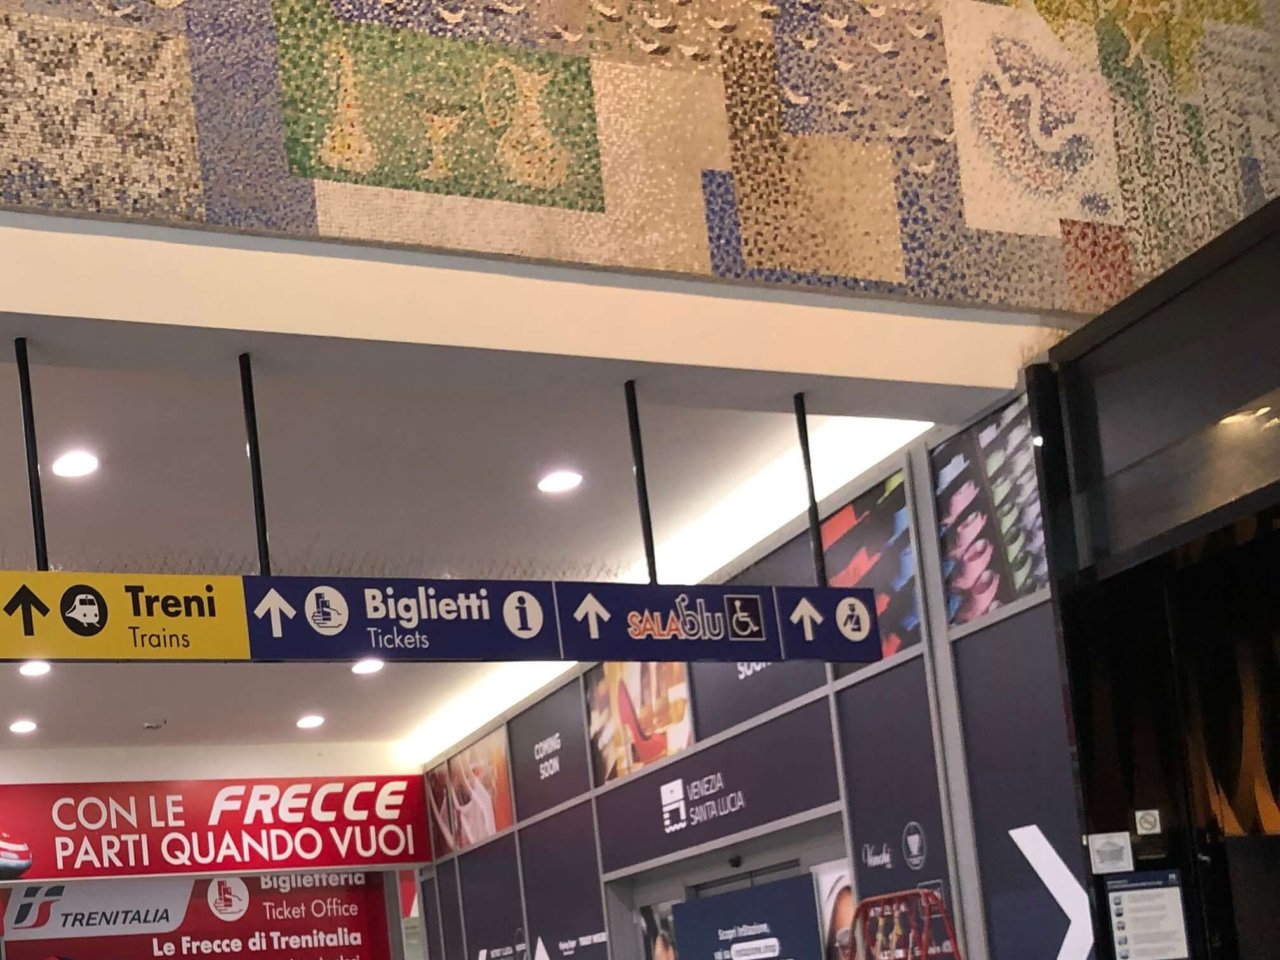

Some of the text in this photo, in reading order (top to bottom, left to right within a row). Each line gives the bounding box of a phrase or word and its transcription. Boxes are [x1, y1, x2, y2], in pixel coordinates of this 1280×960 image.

[125, 584, 216, 618] Treni
[364, 586, 490, 629] Biglietti
[128, 626, 190, 648] Trains
[367, 627, 429, 649] Tickets
[534, 733, 561, 760] COMING
[540, 762, 560, 780] SOON
[687, 773, 724, 800] VENEZIA
[52, 781, 407, 831] CON LE FRECCE
[689, 790, 746, 826] SANTA LUCIA
[55, 823, 414, 870] PARTI QUANDO VUOI
[260, 872, 365, 894] Biglietteria
[61, 908, 170, 928] TRENITALIA
[263, 899, 358, 920] Ticket Office
[153, 928, 362, 957] Le Frecce di Trenitalia
